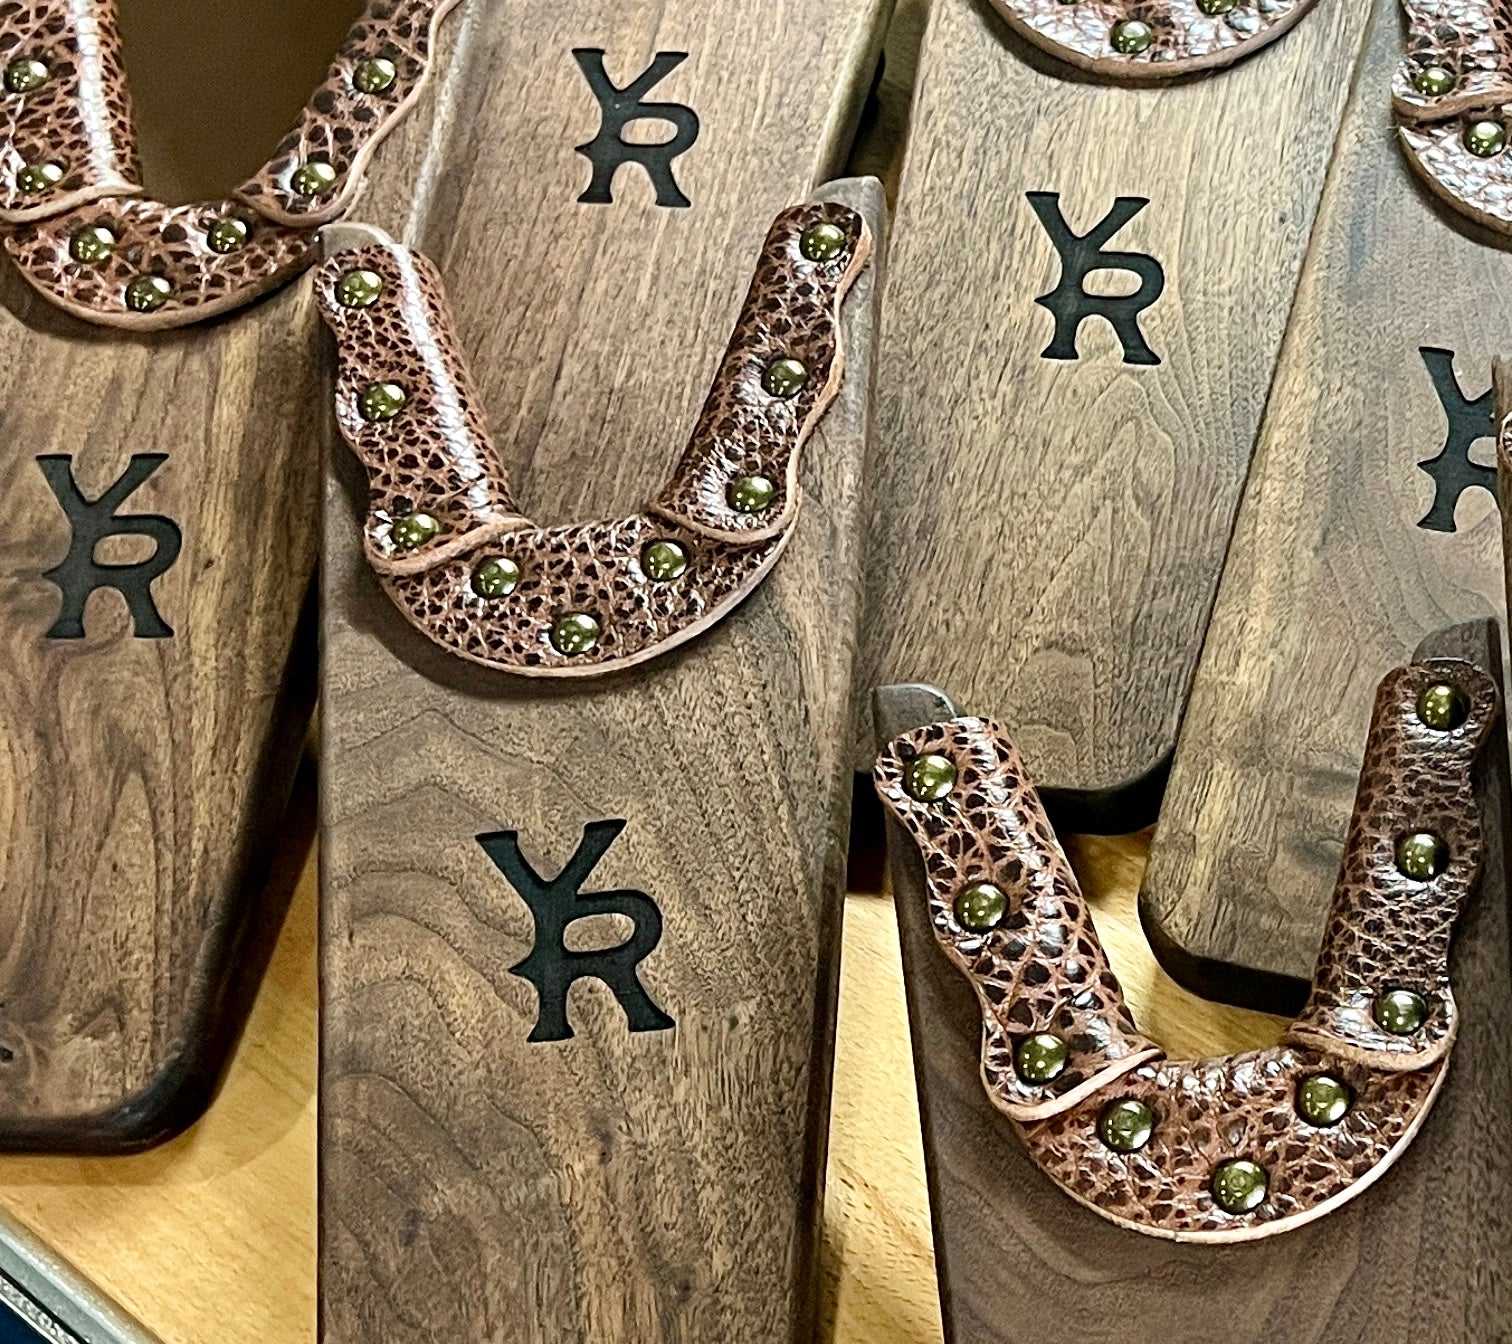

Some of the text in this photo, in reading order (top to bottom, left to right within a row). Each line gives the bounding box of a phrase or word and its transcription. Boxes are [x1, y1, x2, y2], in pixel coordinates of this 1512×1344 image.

[571, 47, 700, 208] YR
[1025, 191, 1165, 365] YR
[35, 453, 183, 639] YR
[475, 819, 676, 1043] YR
